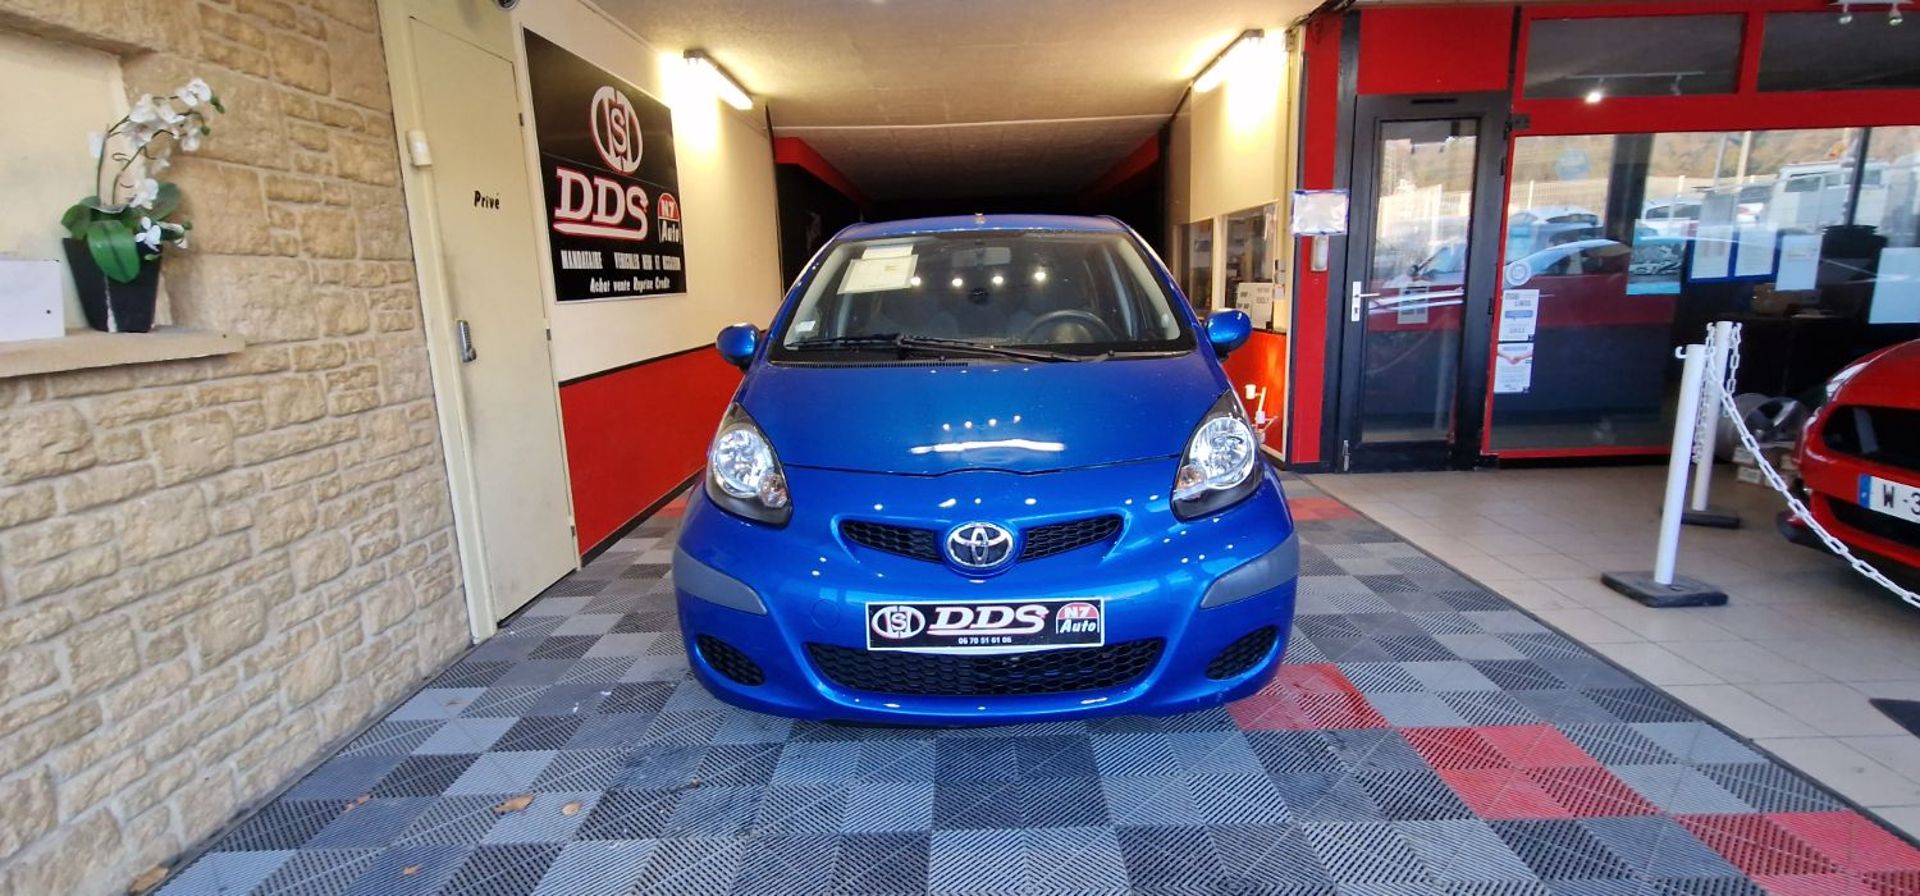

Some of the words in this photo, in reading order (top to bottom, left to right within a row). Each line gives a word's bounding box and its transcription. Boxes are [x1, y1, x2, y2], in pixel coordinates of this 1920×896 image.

[474, 190, 500, 210] Privé
[552, 167, 649, 241] DDS
[661, 219, 680, 243] Auto
[589, 276, 611, 293] Achat
[612, 280, 631, 292] vente
[632, 275, 654, 293] Reprise
[926, 604, 1049, 635] DDS
[1064, 605, 1091, 619] N7
[1059, 618, 1098, 634] Auto
[958, 636, 968, 645] 06
[969, 636, 979, 645] 70
